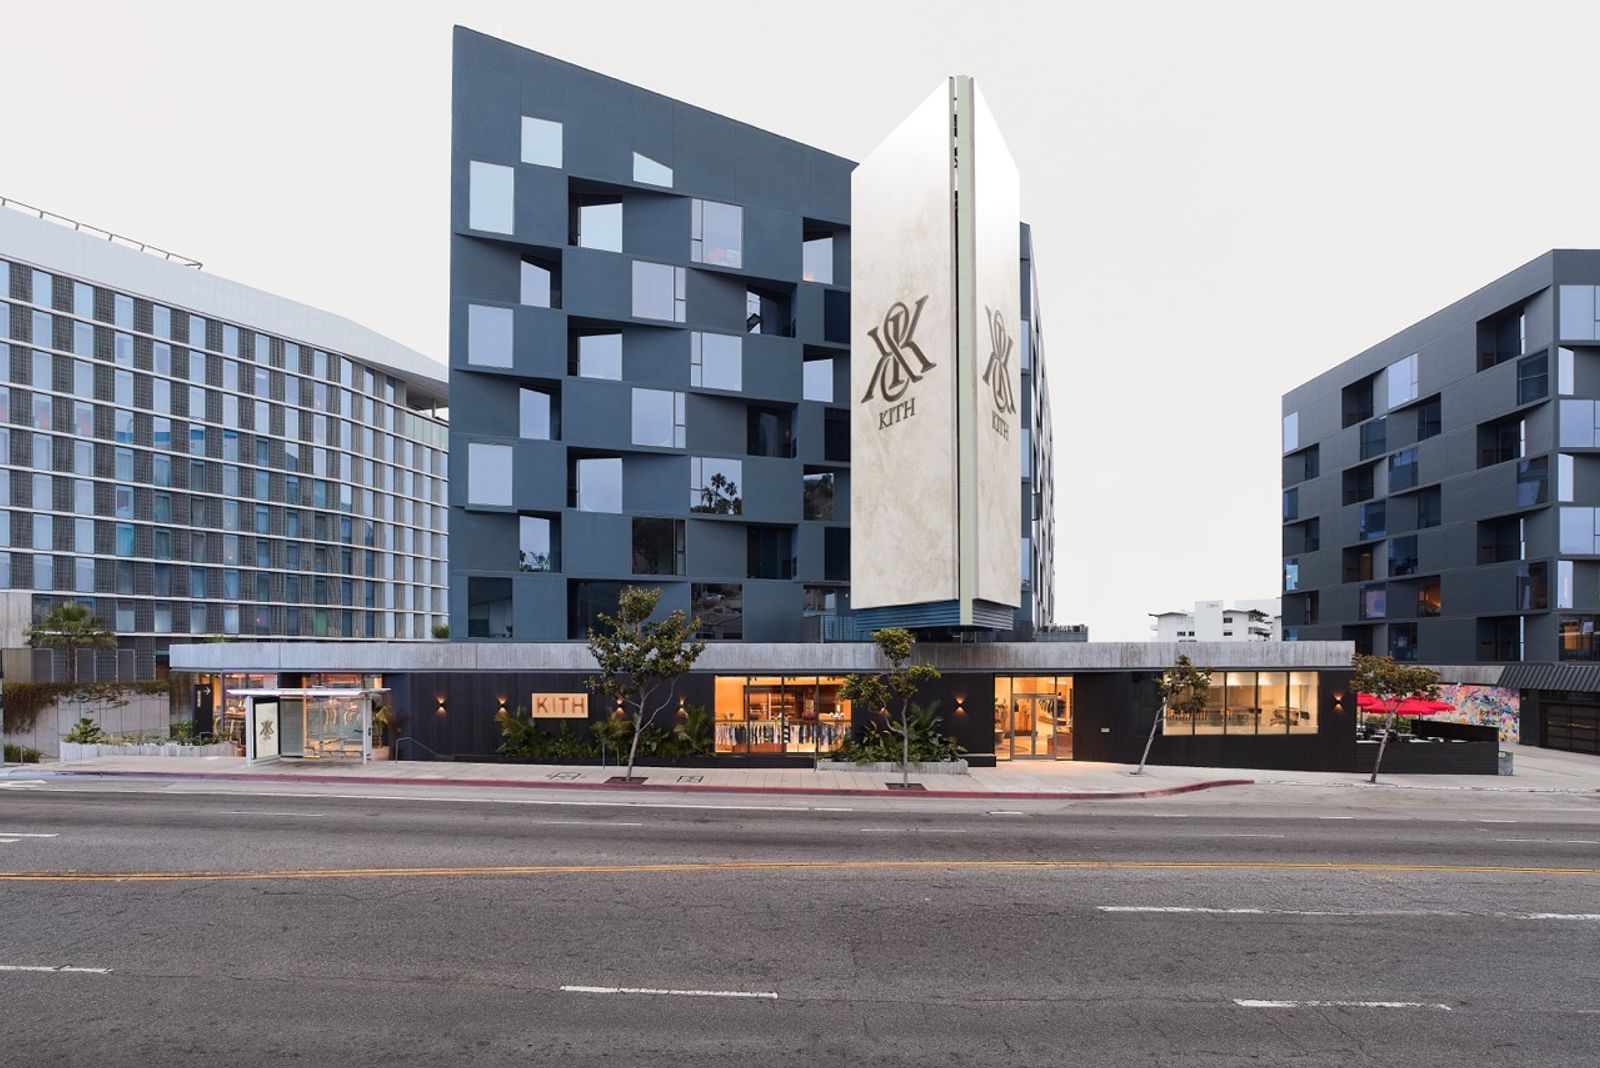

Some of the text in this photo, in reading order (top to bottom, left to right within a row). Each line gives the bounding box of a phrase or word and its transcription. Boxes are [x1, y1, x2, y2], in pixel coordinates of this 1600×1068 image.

[878, 397, 916, 430] KITH
[992, 410, 1010, 441] KITH
[536, 697, 585, 714] KITH
